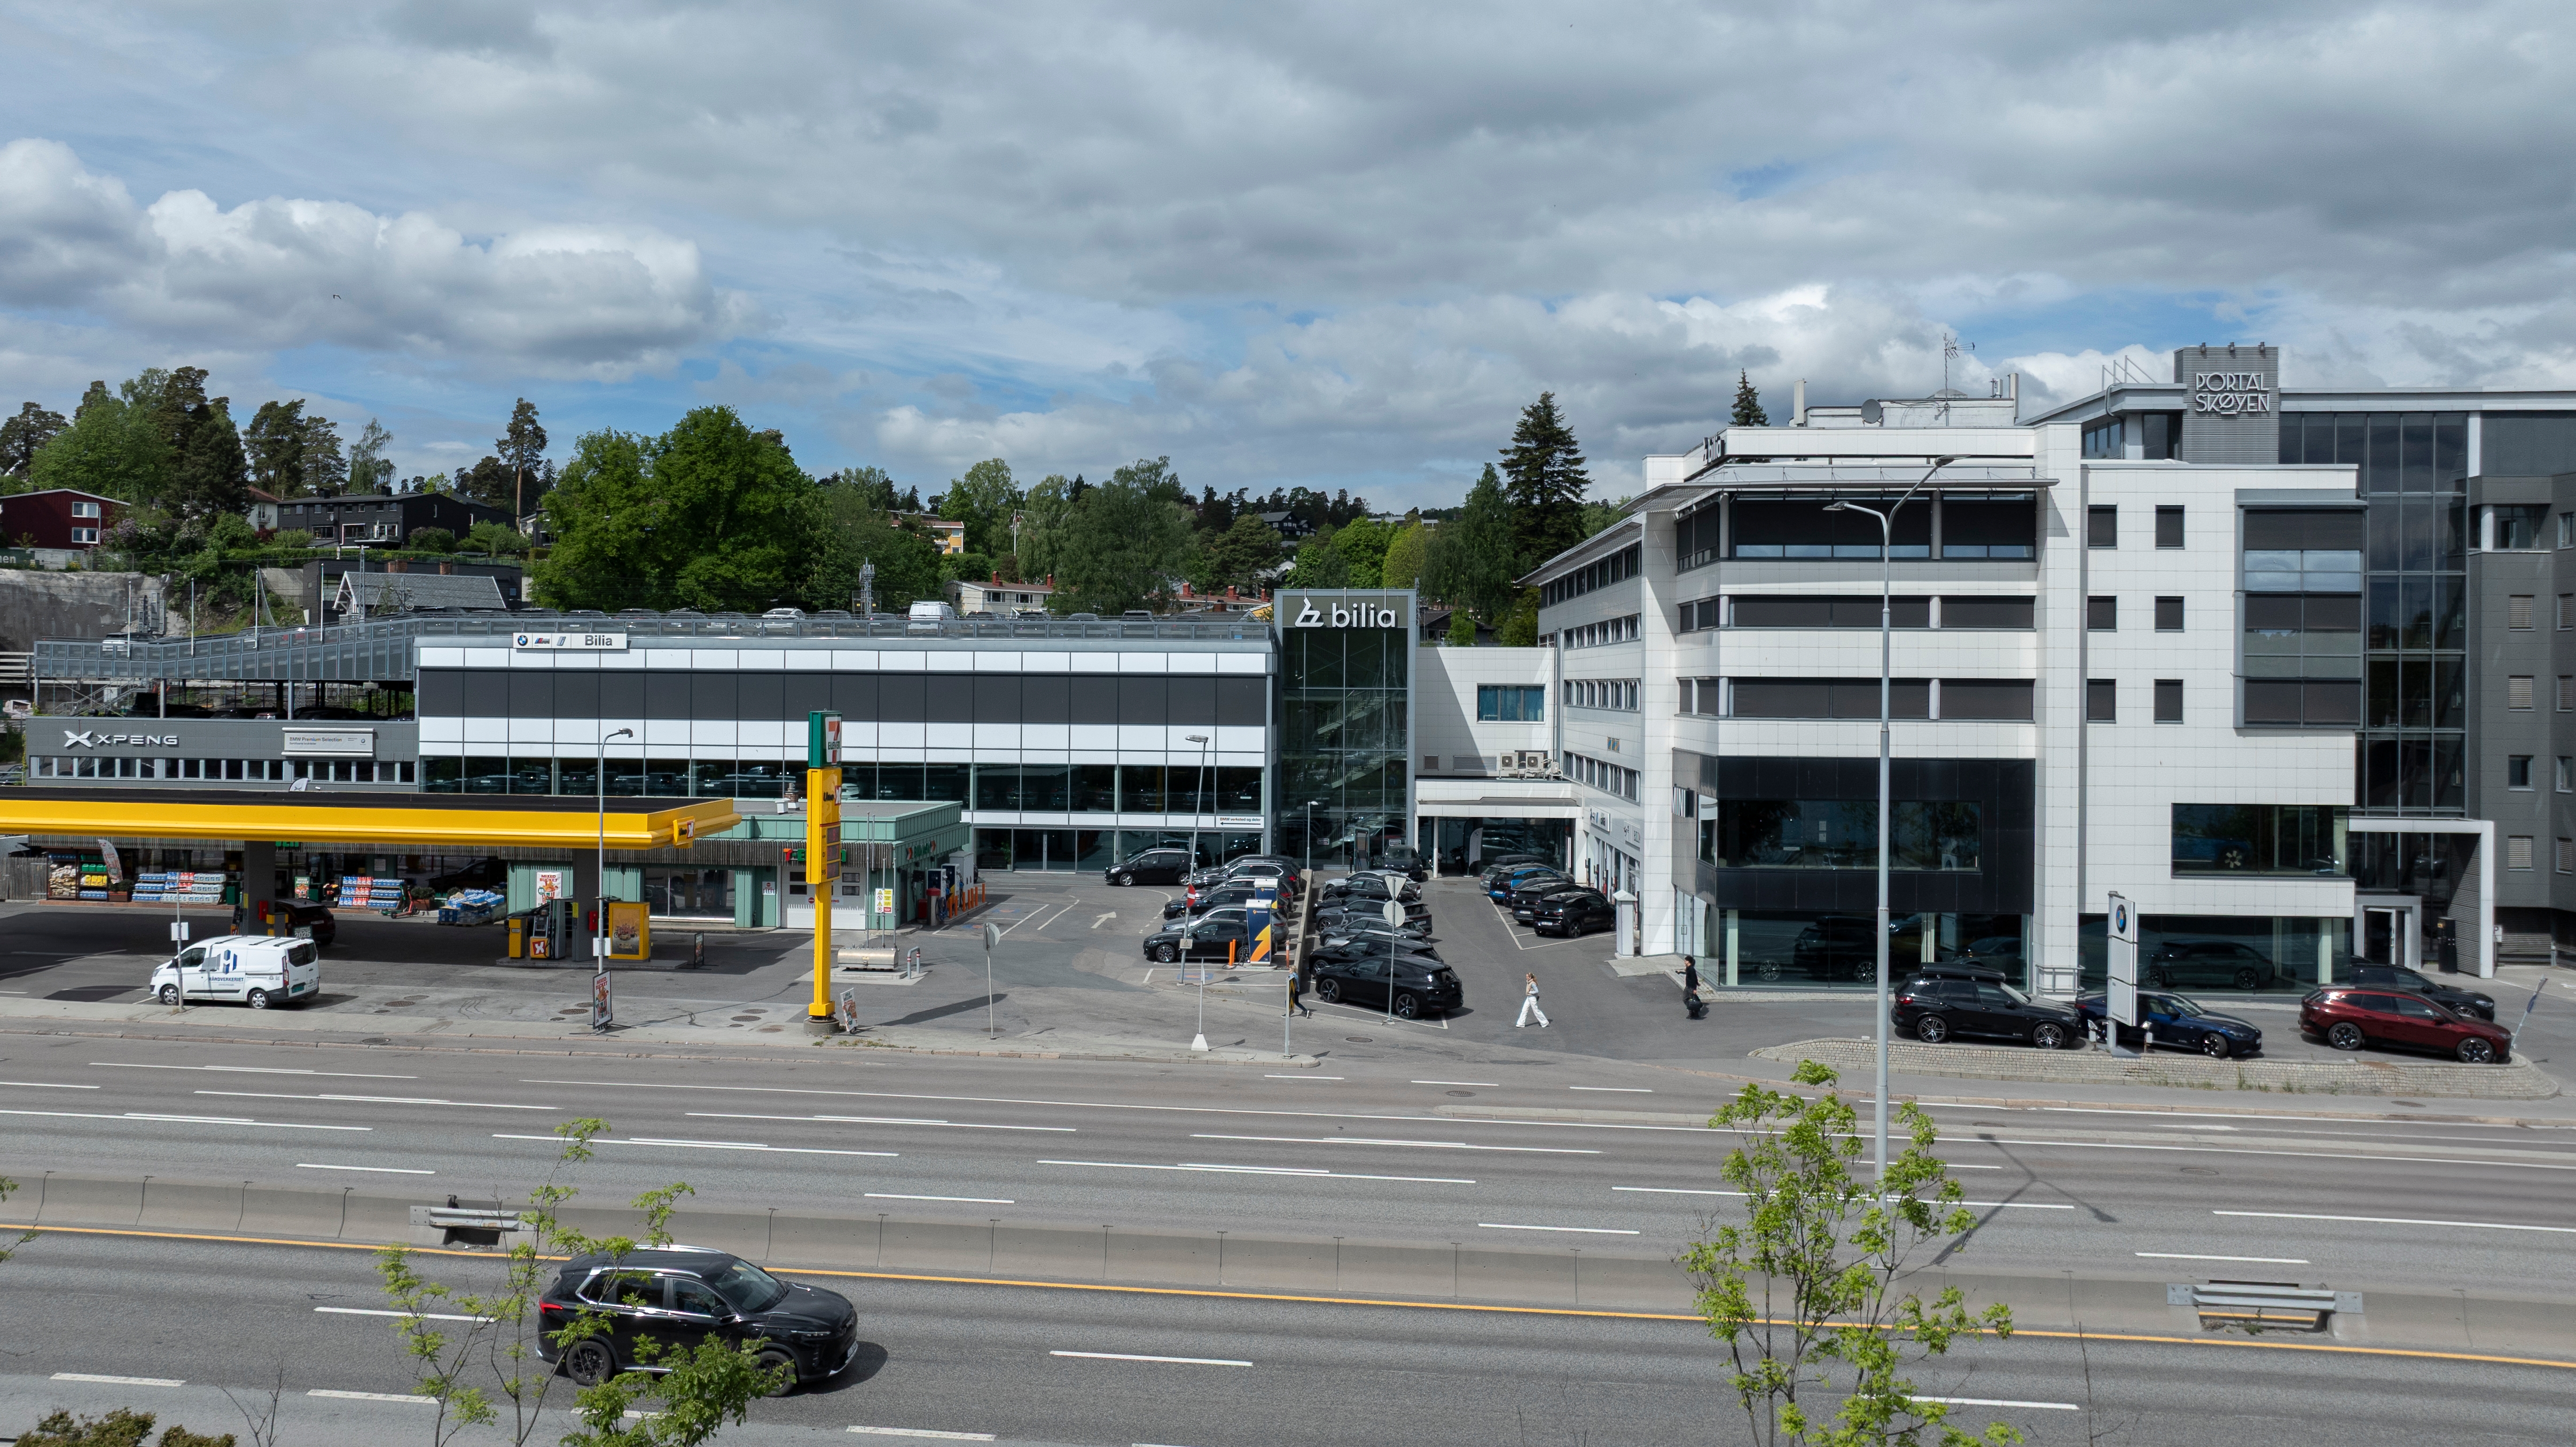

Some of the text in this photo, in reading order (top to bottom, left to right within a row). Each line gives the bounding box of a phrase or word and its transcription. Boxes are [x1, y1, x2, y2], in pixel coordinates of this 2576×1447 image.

[2196, 373, 2269, 391] PORTAL
[2196, 393, 2269, 414] SKØYEN
[1332, 602, 1395, 627] bilia
[585, 635, 613, 646] Bilia
[97, 735, 178, 745] XPENG
